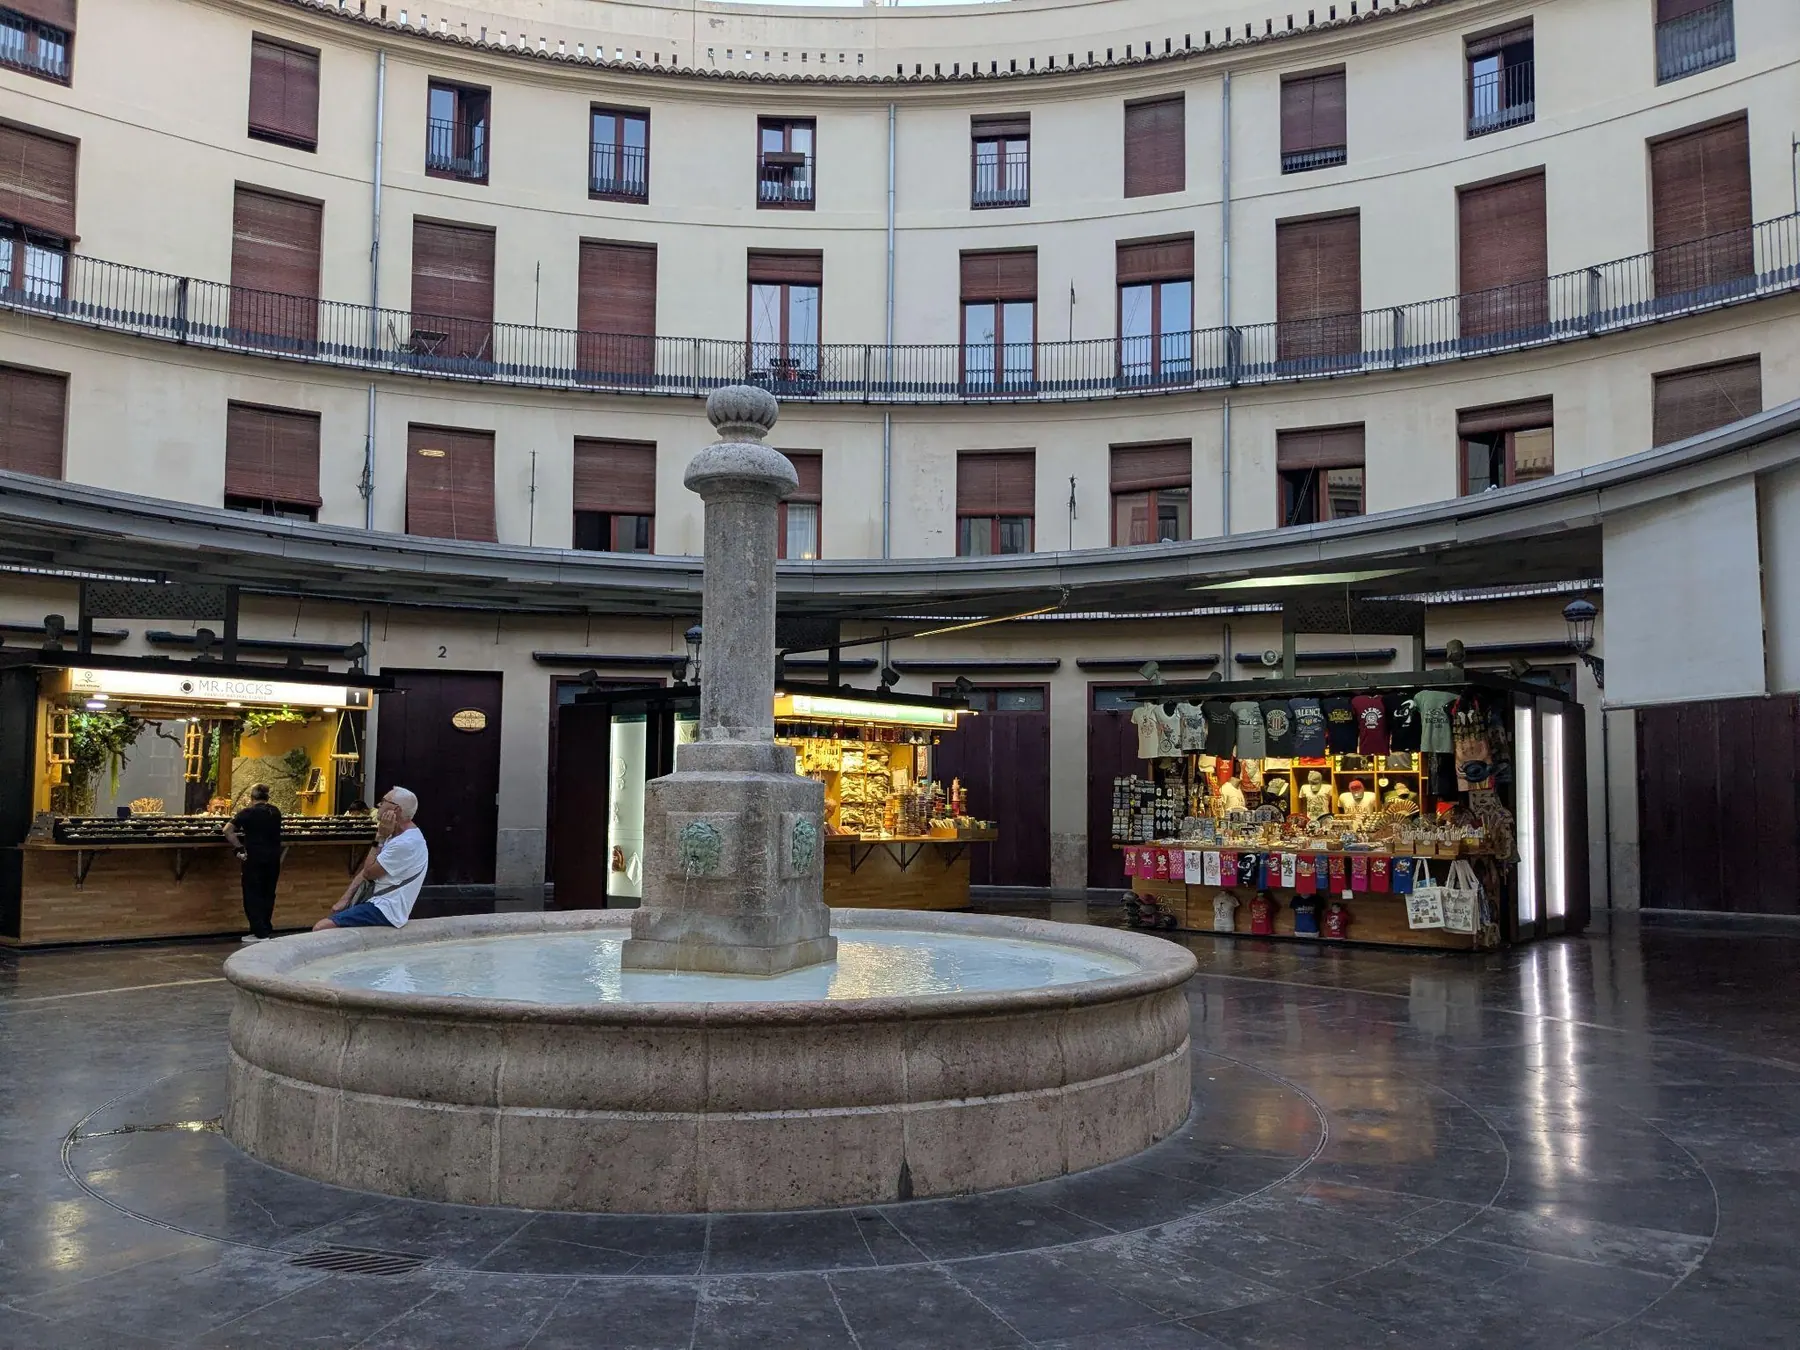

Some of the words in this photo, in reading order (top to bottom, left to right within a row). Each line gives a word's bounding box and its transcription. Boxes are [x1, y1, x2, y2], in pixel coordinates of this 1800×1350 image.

[438, 646, 447, 658] 2
[199, 680, 273, 696] MR.ROCKS
[354, 692, 360, 703] 1
